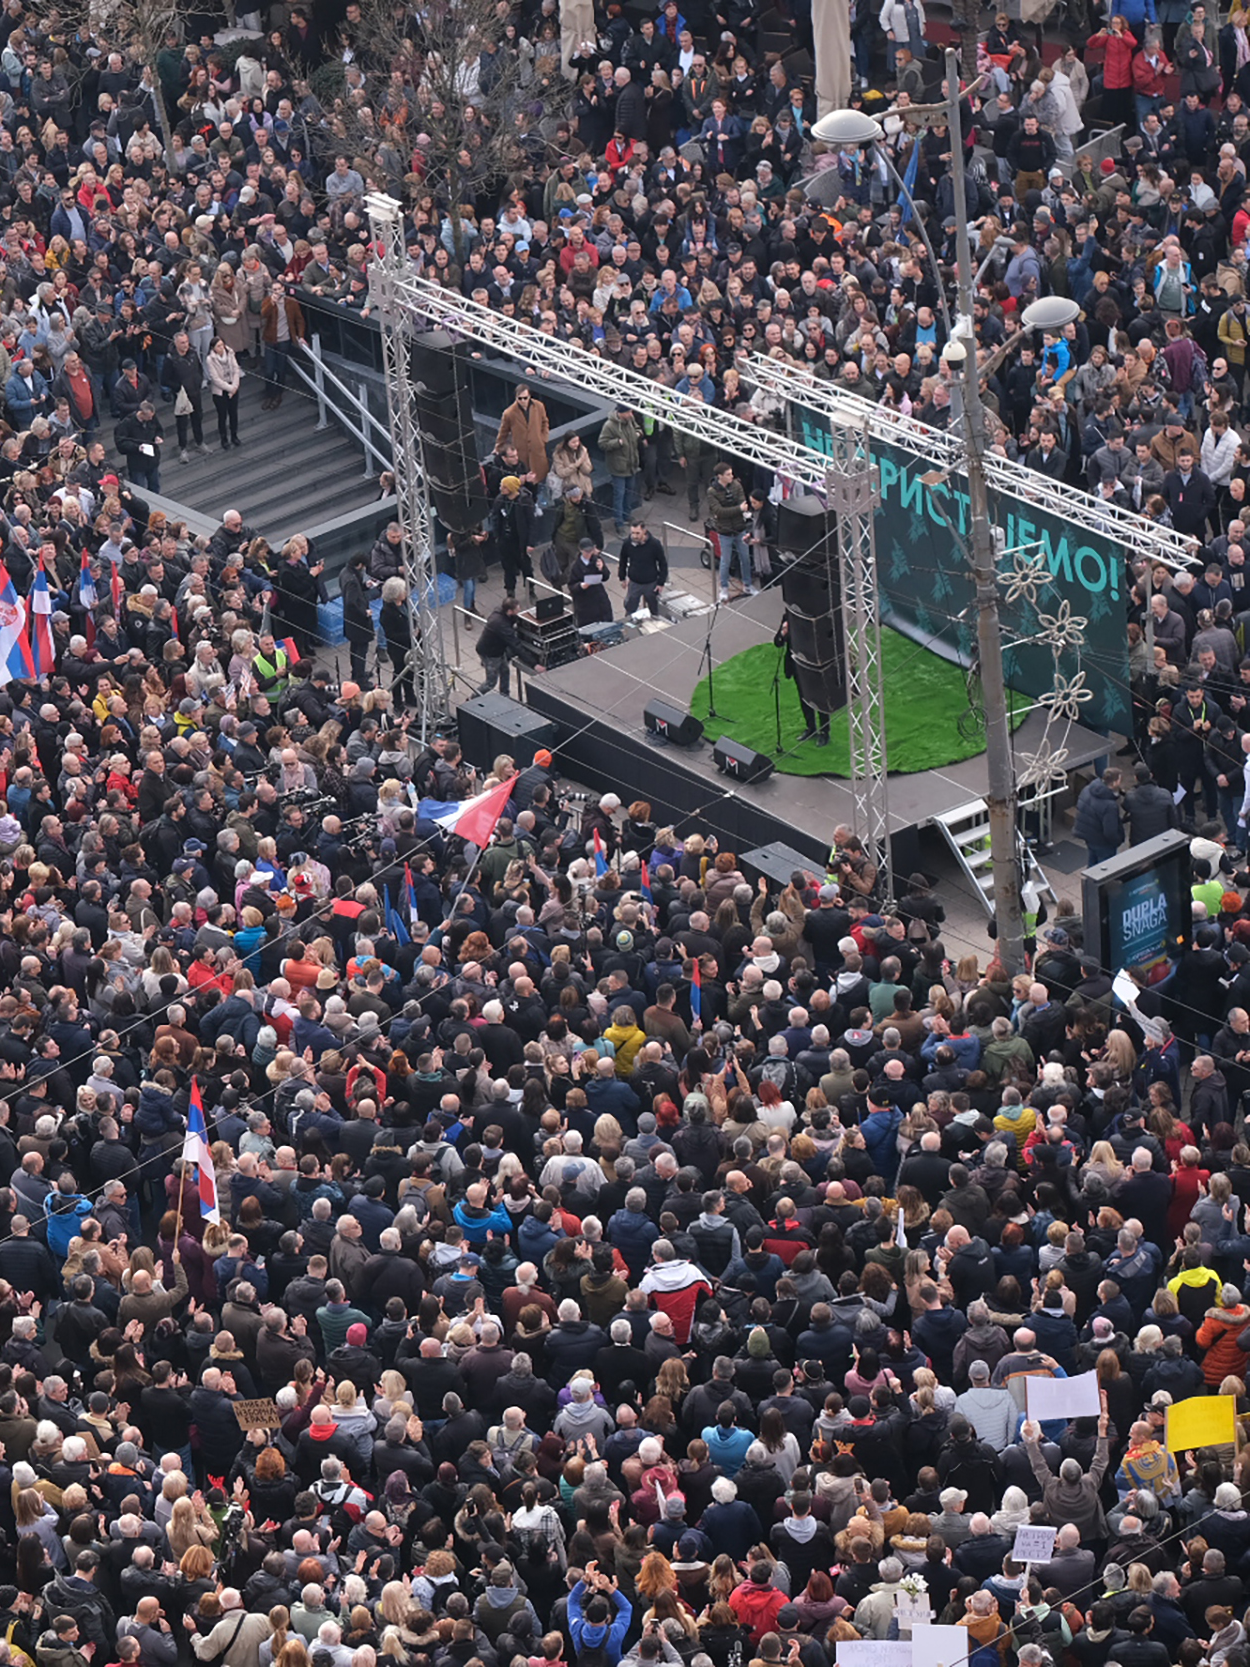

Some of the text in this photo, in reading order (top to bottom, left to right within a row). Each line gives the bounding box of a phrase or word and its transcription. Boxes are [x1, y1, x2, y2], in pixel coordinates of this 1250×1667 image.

[855, 446, 1119, 602] РИСТЈЕМО!
[1122, 892, 1168, 926] DUPLA
[1123, 908, 1168, 942] SNAGA
